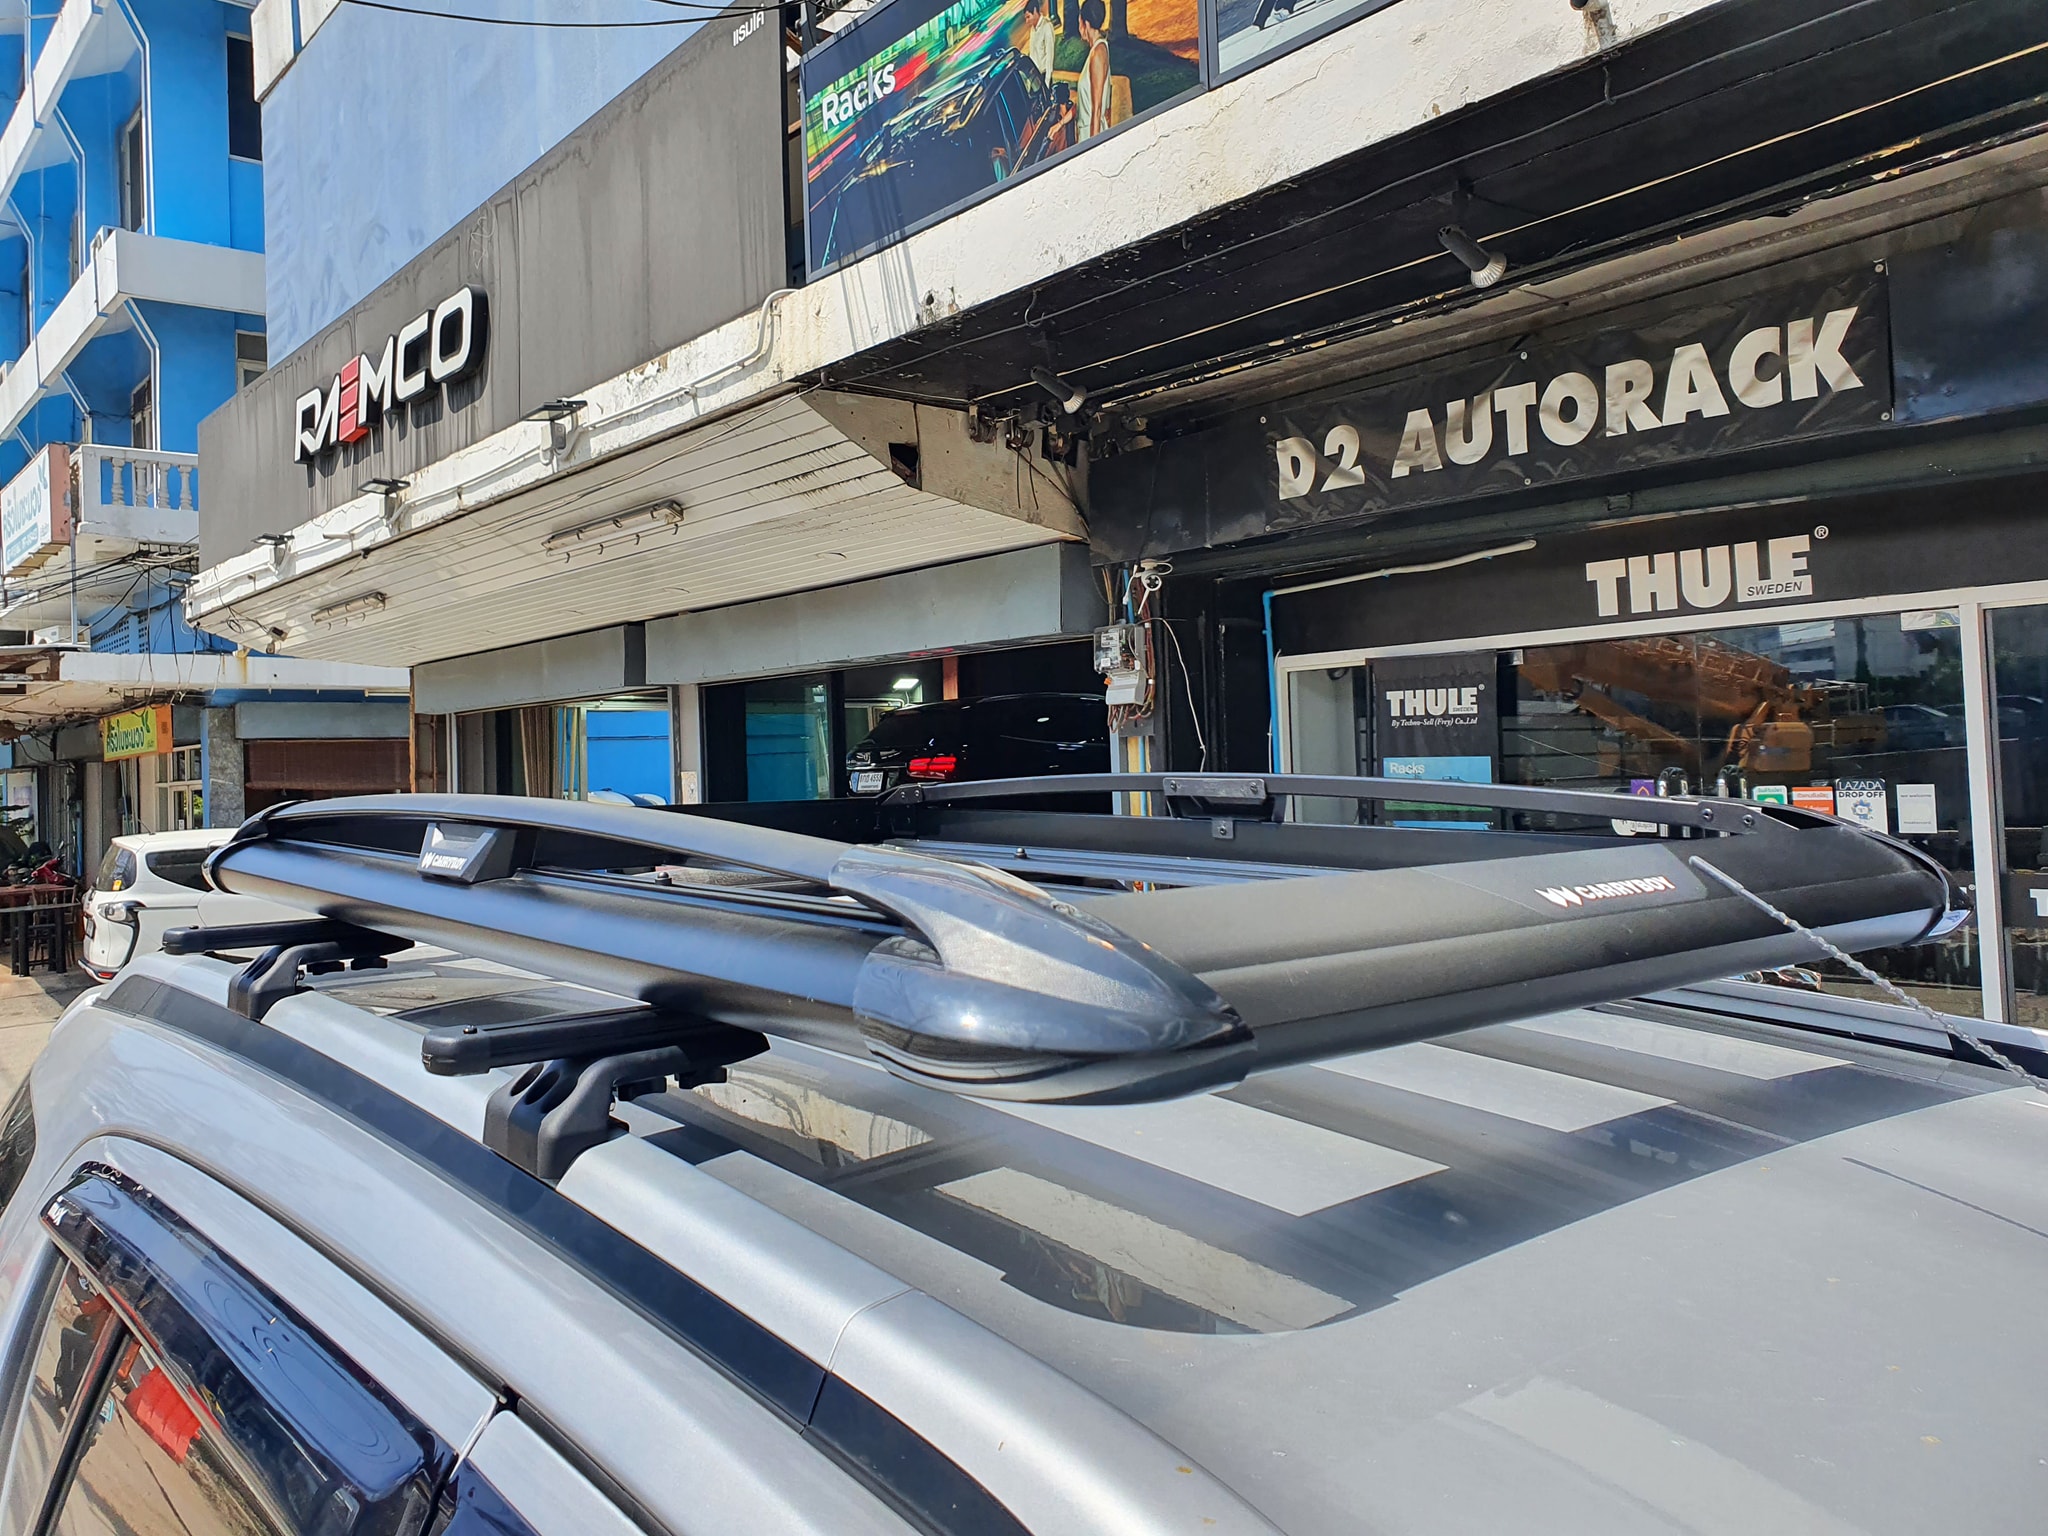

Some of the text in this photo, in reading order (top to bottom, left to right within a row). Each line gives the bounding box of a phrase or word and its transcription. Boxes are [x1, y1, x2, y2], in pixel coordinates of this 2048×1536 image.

[822, 63, 896, 133] Racks
[1390, 306, 1864, 480] AUTORACK
[1585, 534, 1813, 617] THULE
[1746, 580, 1803, 597] SWEDEN
[1386, 687, 1478, 717] THULE
[1389, 762, 1425, 775] Racks
[1838, 780, 1882, 791] LAZADA
[1573, 874, 1677, 901] CARRYBOY
